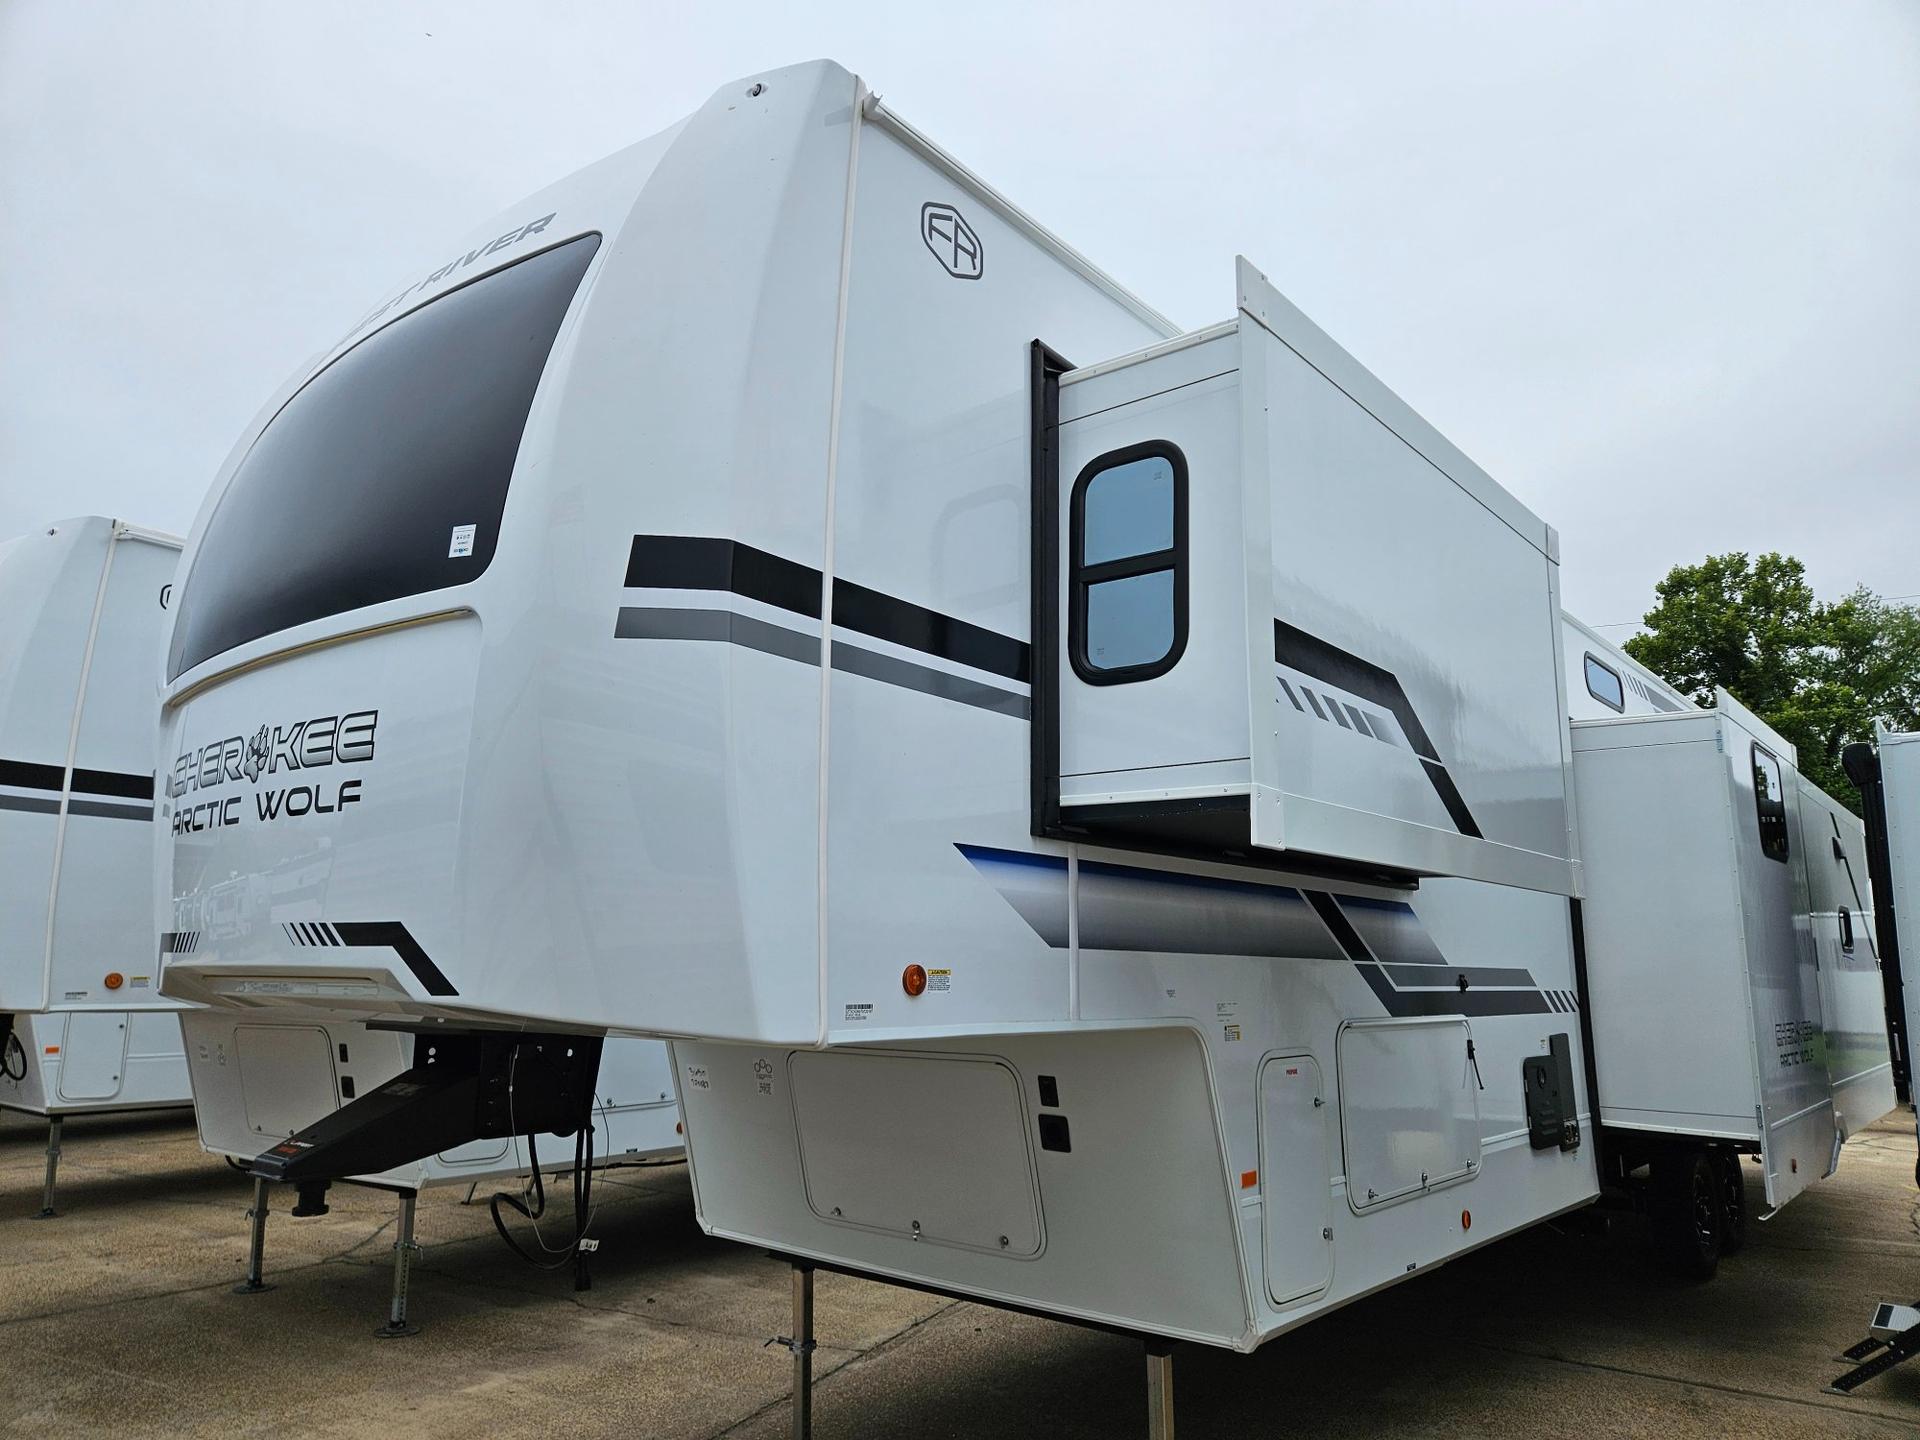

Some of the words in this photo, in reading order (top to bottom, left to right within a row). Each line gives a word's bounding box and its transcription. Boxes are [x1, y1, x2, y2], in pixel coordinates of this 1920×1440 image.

[417, 212, 557, 291] RIVER
[171, 796, 242, 837] ARCTIC
[256, 779, 362, 821] WOLF
